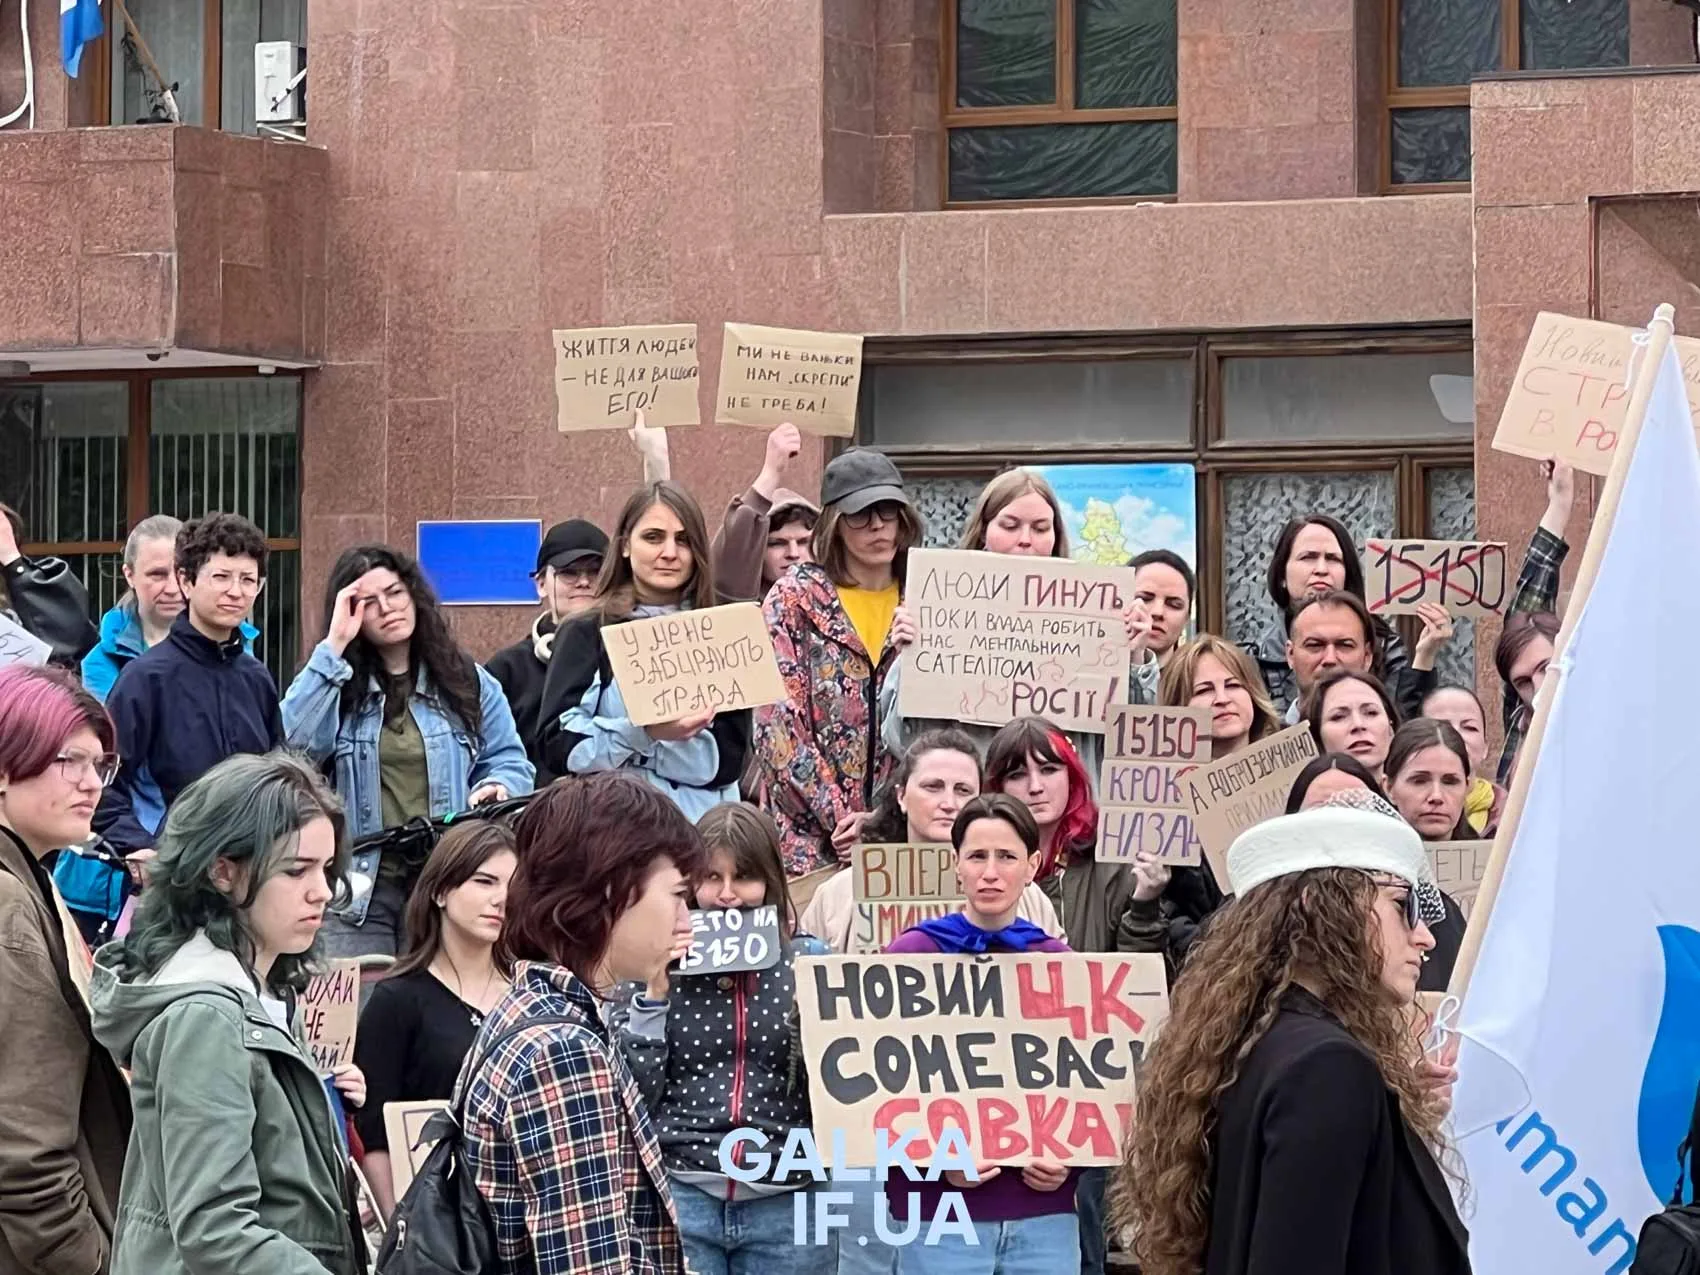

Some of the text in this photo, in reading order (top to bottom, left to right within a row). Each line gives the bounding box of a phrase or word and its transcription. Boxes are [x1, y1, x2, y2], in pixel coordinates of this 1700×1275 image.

[562, 337, 631, 359] ЖИТТЯ
[737, 345, 763, 359] МИ
[771, 349, 791, 361] НЕ
[584, 367, 609, 387] НЕ
[613, 366, 647, 388] ДЛЯ
[746, 367, 781, 383] НАМ
[1522, 366, 1632, 411] СТР
[607, 384, 659, 416] ЕГО!
[727, 396, 827, 415] НЕ ТРЕБА!
[1576, 419, 1618, 451] РО
[921, 567, 1010, 602] ЛЮДИ
[1374, 543, 1506, 610] 15150
[919, 606, 1107, 640] ПОКИ ВЛАДА РОБИТЬ
[620, 626, 641, 659] У
[920, 632, 1082, 658] НАС МЕНТАЛЬНИМ
[915, 650, 1036, 682] САТЕЛІТОМ
[652, 676, 746, 717] ПРАВА
[1189, 730, 1317, 816] А ДОБРОЗВИЧАЙНО
[753, 908, 778, 927] НА
[813, 955, 1004, 1020] НОВИЙ
